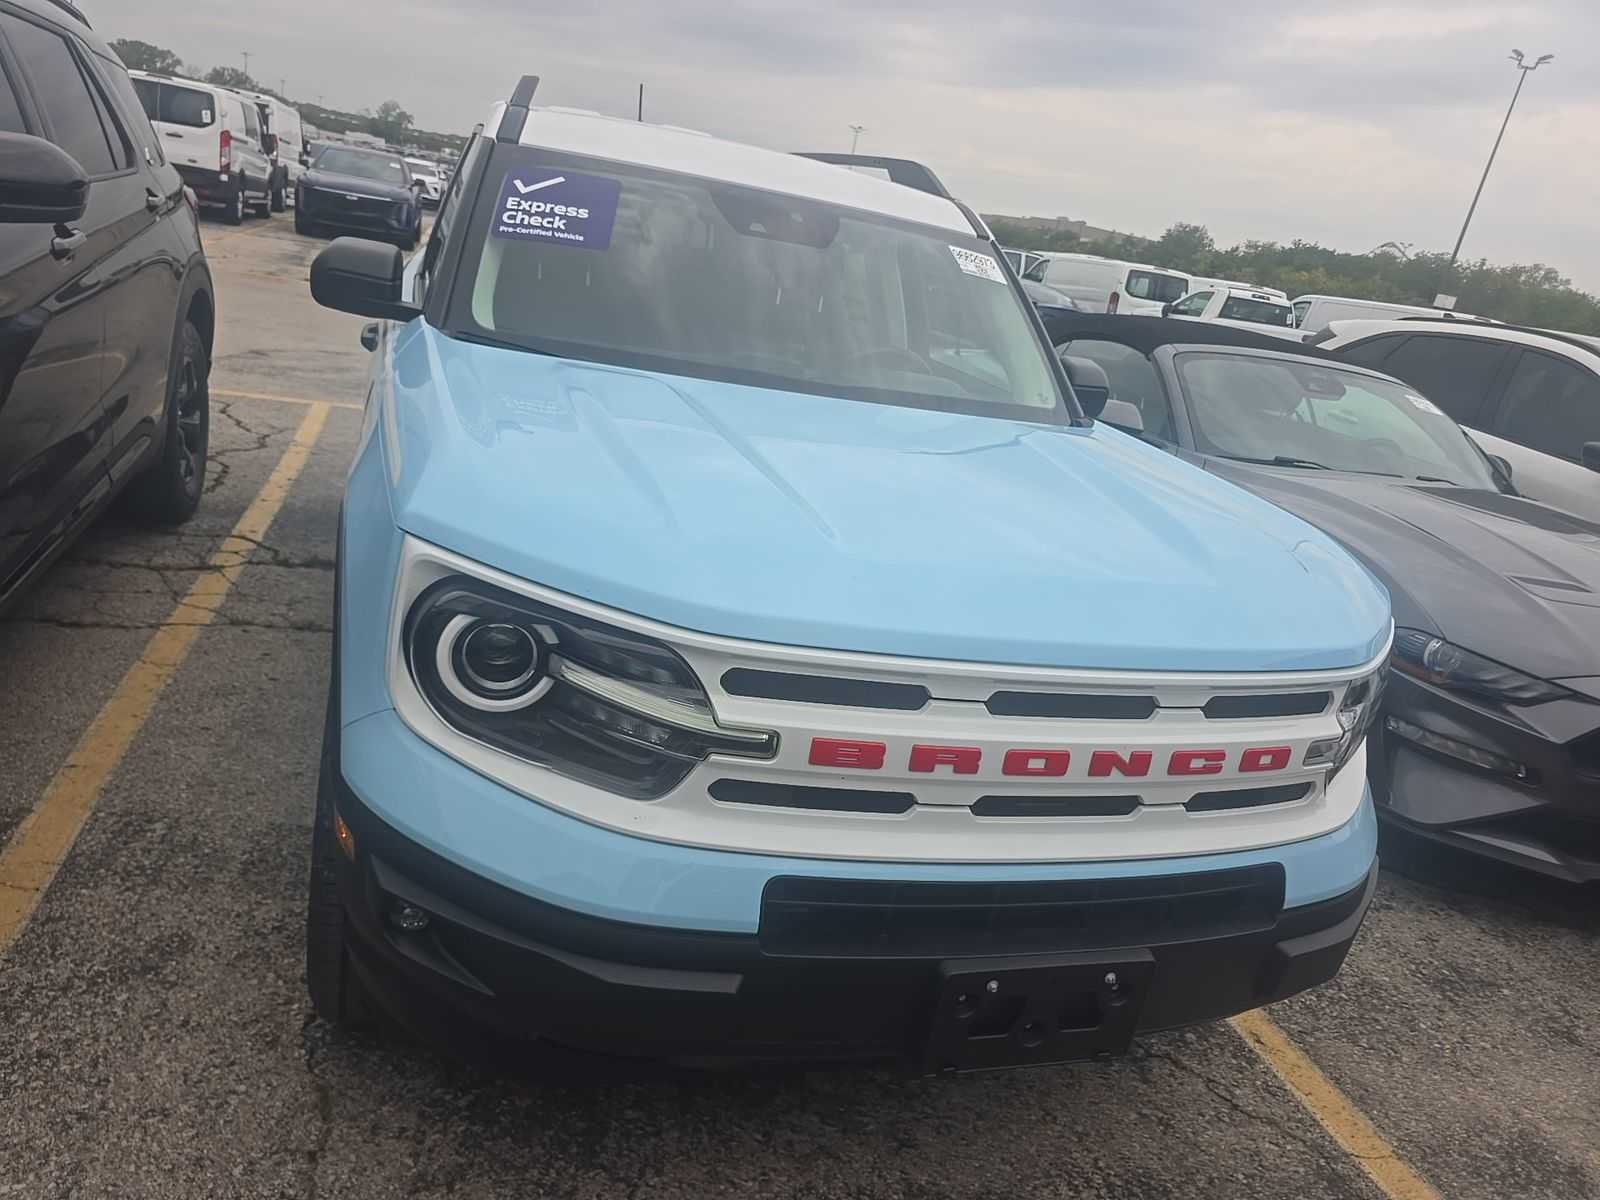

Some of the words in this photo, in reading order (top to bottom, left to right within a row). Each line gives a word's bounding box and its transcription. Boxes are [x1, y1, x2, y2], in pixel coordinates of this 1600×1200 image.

[506, 197, 589, 218] Express
[502, 211, 567, 230] Check
[499, 225, 552, 237] Pre-Certified
[554, 231, 584, 241] Vehicle
[808, 737, 1291, 777] BRONCO
